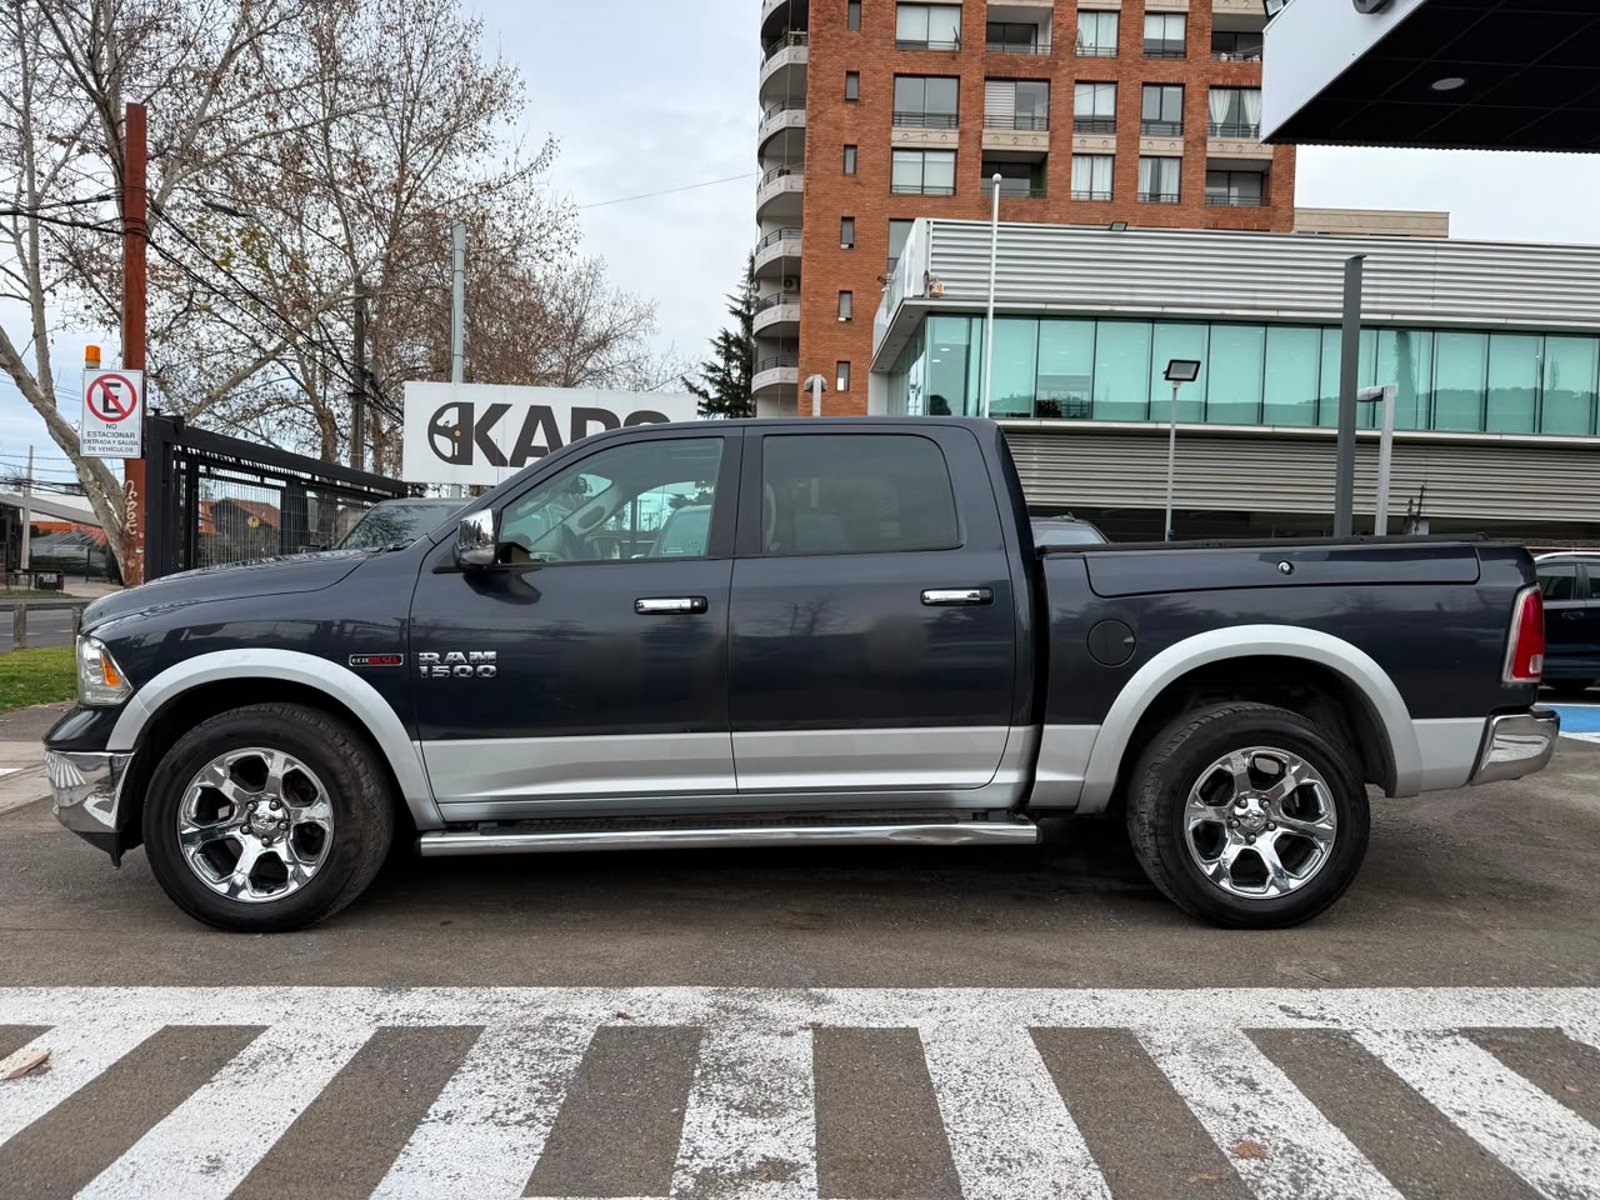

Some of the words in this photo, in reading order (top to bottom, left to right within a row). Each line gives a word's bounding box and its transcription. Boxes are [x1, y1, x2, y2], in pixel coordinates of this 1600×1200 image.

[458, 402, 671, 468] KA
[418, 651, 497, 665] RAM
[419, 664, 497, 679] 1500
